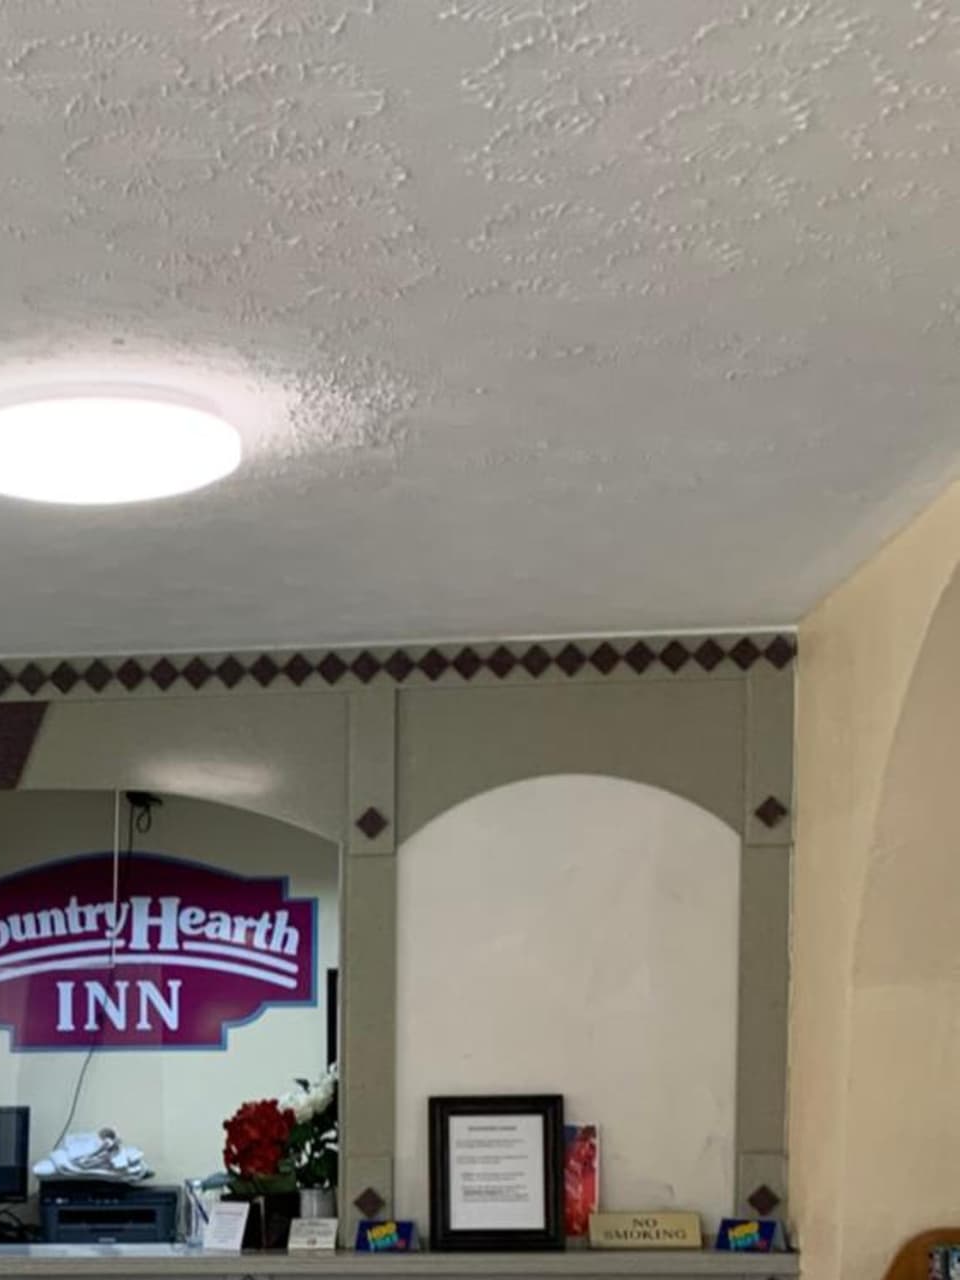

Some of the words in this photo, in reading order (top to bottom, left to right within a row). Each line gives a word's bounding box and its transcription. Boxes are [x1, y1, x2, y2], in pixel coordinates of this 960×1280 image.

[56, 979, 182, 1032] INN
[632, 1218, 658, 1228] NO
[603, 1229, 687, 1240] SMOKING
